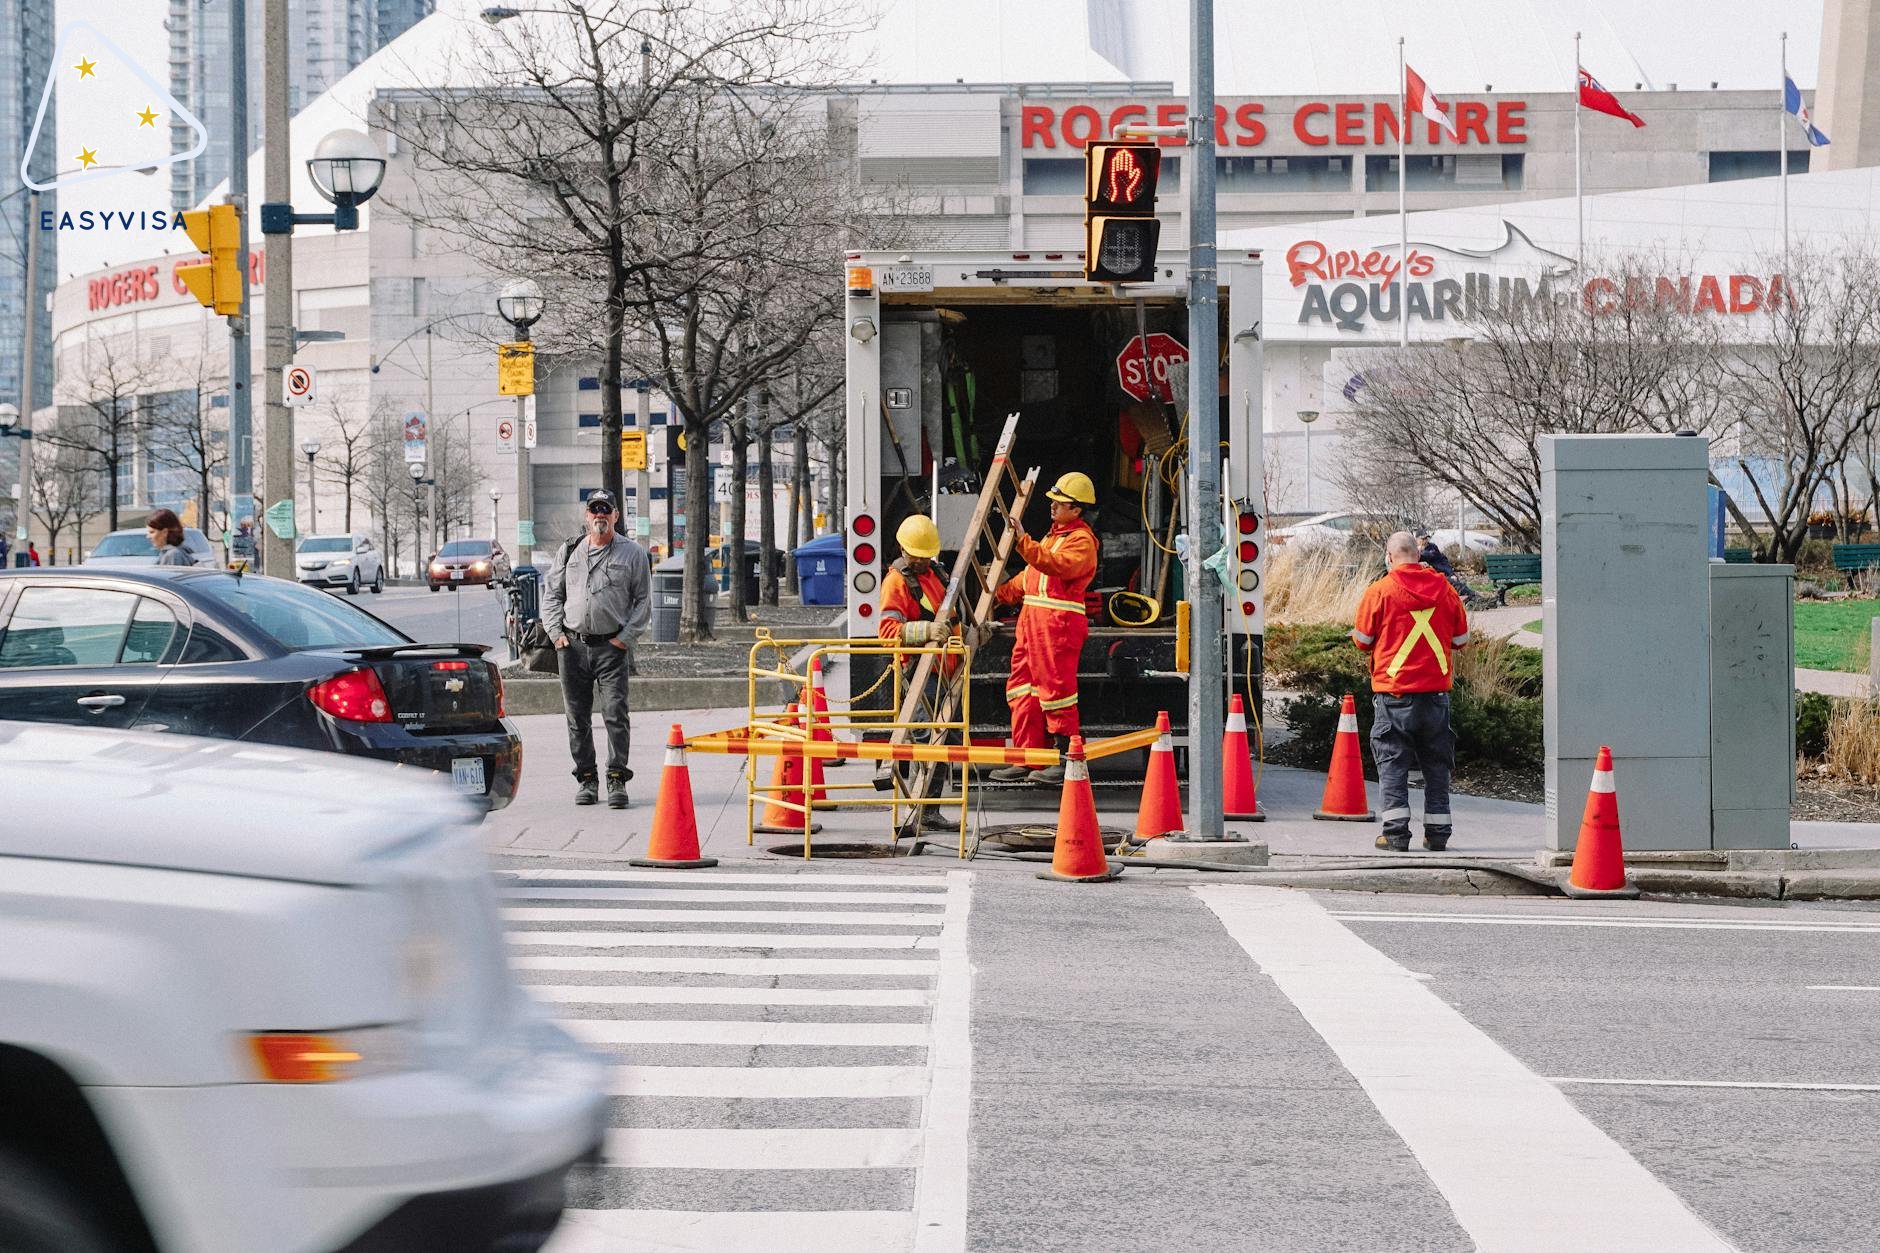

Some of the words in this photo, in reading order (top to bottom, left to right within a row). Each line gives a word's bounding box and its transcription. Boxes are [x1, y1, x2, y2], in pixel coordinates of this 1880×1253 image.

[1293, 101, 1527, 145] CENTRE
[87, 265, 159, 311] ROGERS
[1298, 272, 1549, 332] AQUARIUM
[1584, 273, 1798, 317] CANADA
